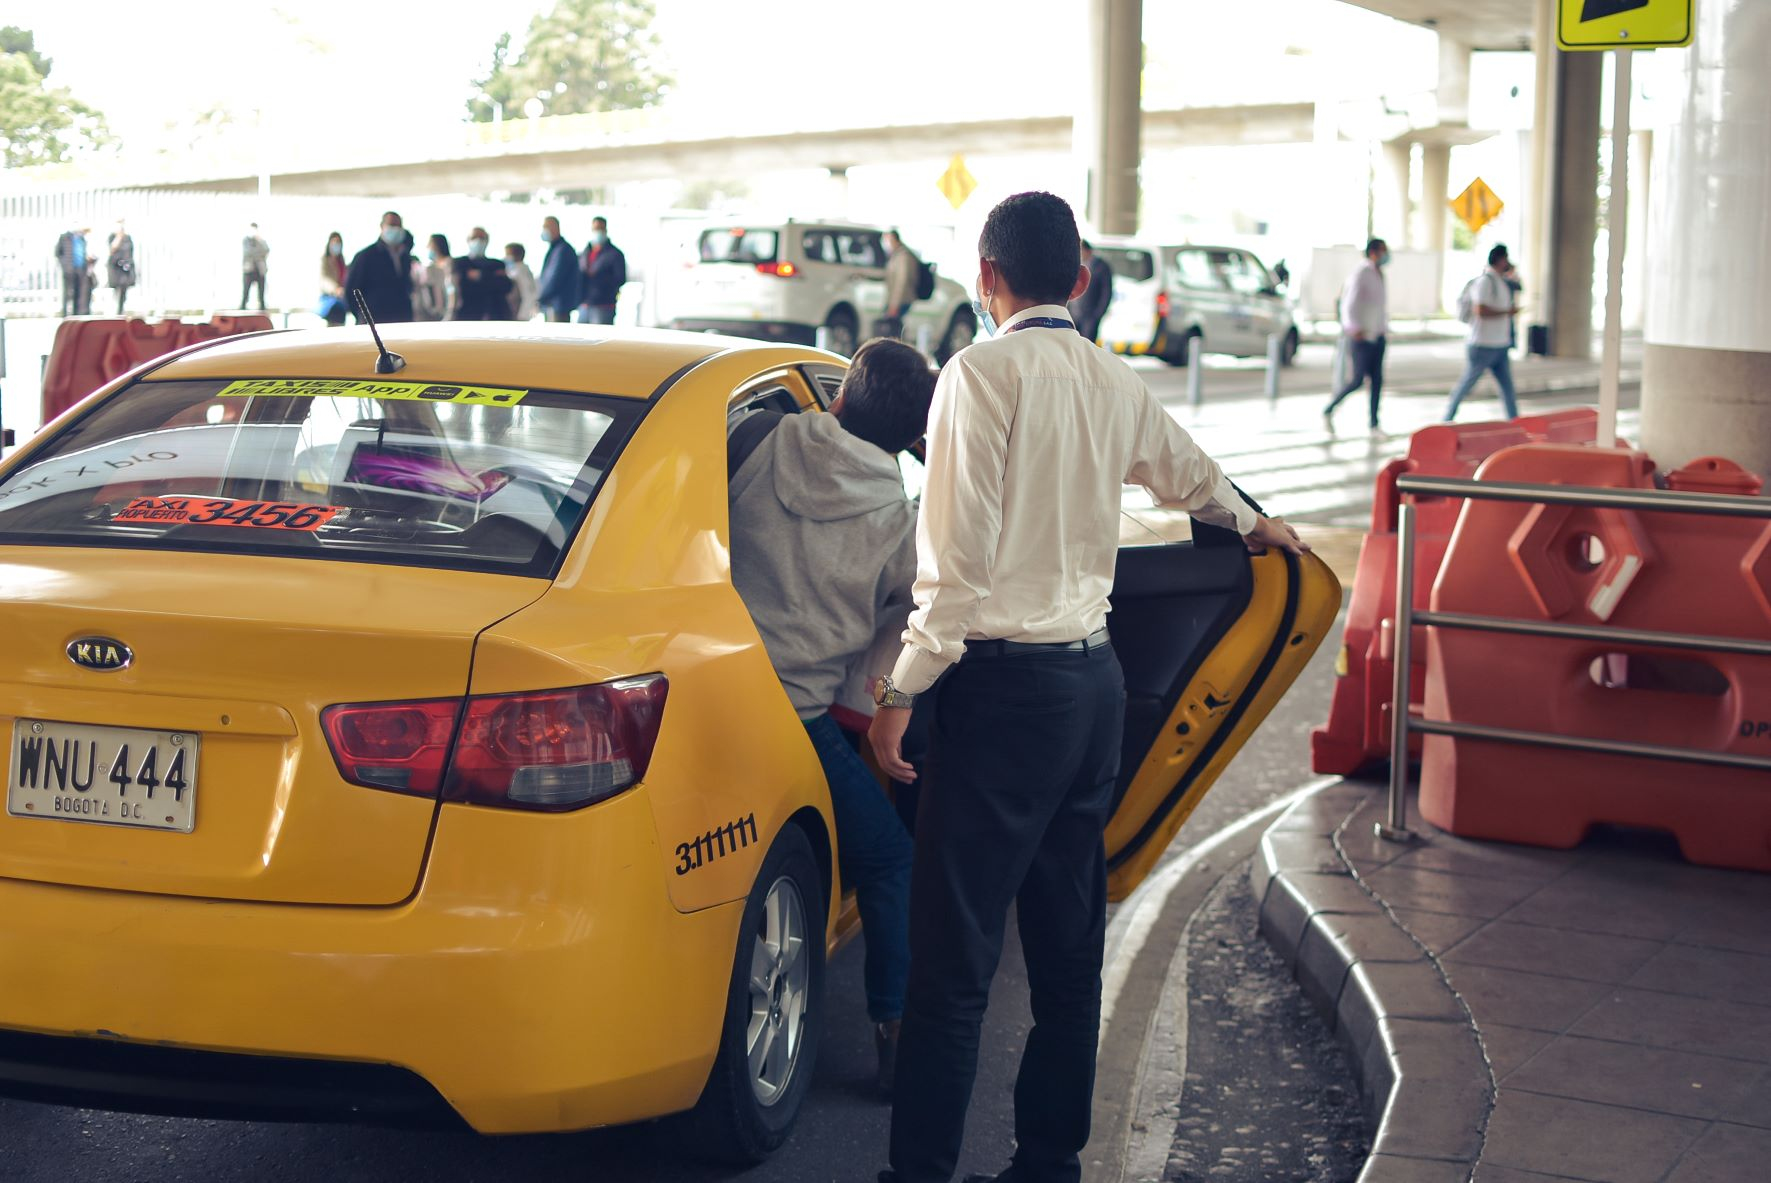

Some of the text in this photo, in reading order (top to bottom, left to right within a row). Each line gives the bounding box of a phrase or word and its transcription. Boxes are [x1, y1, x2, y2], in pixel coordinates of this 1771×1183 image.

[244, 380, 329, 388] TAXIS
[254, 387, 349, 395] LIBRES
[353, 384, 412, 396] App
[188, 500, 328, 529] 3456
[77, 643, 121, 665] KIA
[1740, 719, 1771, 738] OP
[19, 736, 188, 801] WNU 444
[54, 796, 110, 817] BOGOTA
[675, 812, 759, 876] 3.111111
